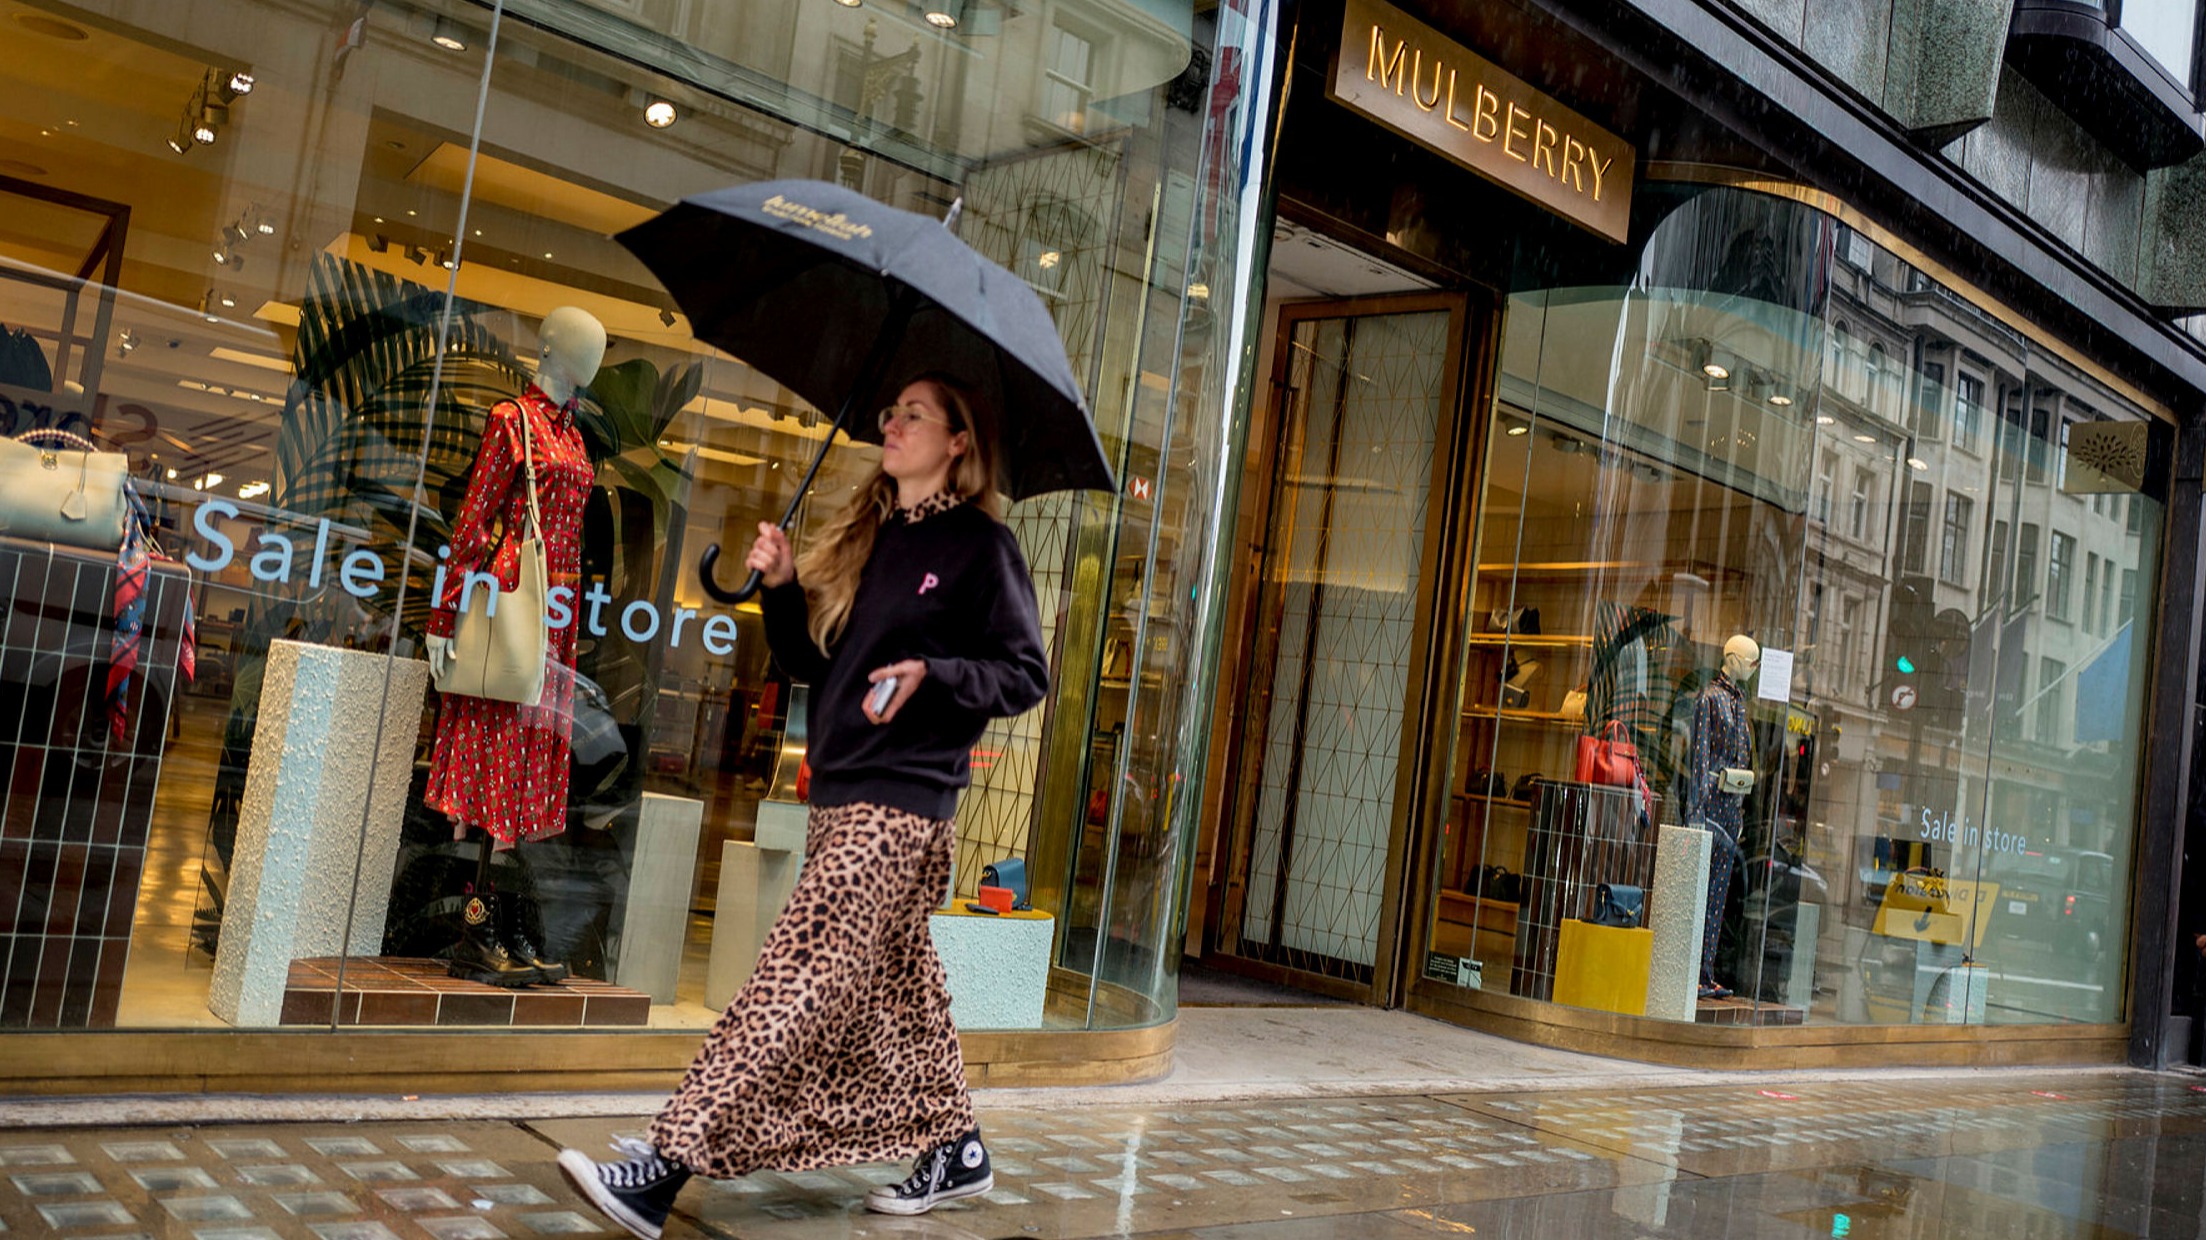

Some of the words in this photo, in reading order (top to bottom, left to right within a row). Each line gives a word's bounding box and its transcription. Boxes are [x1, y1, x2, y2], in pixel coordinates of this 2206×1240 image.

[1365, 24, 1614, 202] MULBERRY
[185, 500, 385, 597] Sale
[430, 545, 499, 618] in
[542, 581, 738, 656] store
[918, 572, 939, 595] P
[1920, 807, 1957, 843] Sale
[1963, 816, 1978, 847] in
[1985, 826, 2026, 856] store
